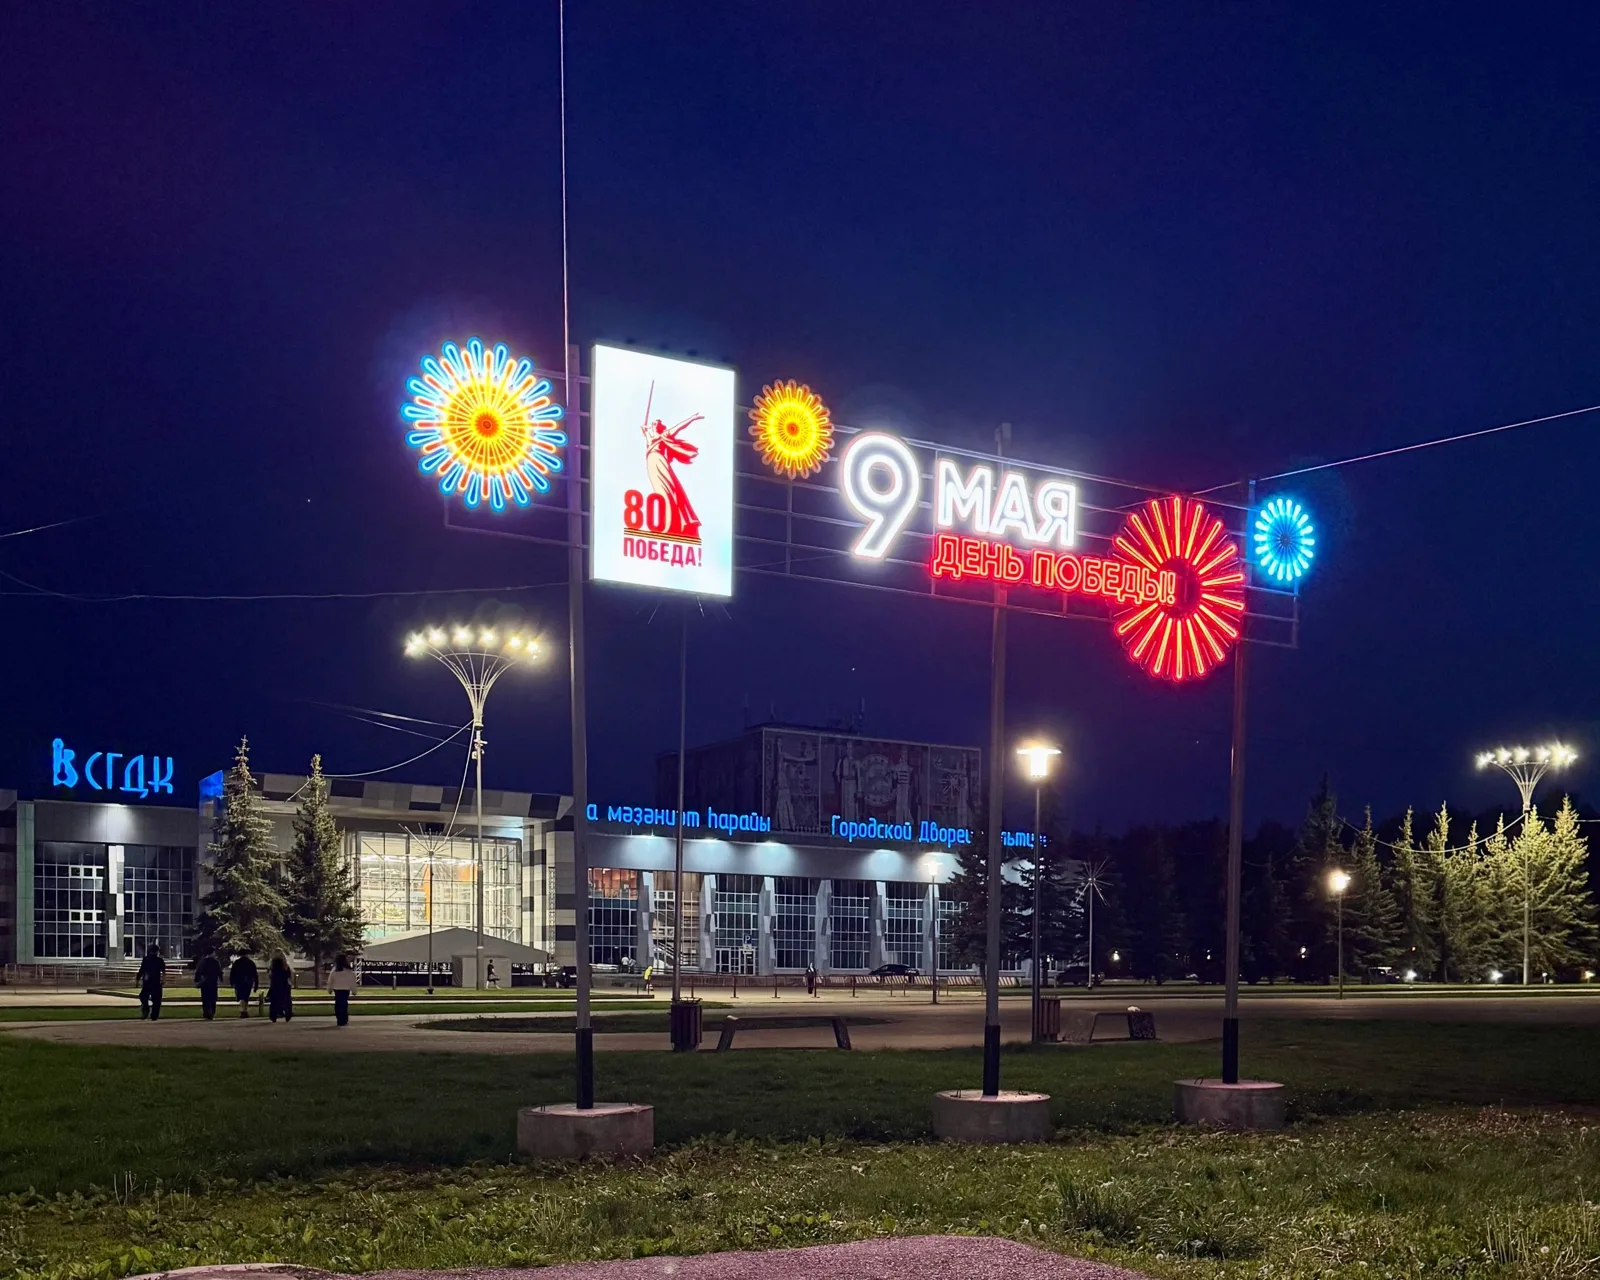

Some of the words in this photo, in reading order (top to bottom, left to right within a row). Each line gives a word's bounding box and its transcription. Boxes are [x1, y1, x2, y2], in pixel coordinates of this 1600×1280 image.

[623, 488, 667, 533] 80
[841, 431, 920, 561] 9
[935, 458, 1079, 549] МАЯ
[623, 536, 703, 568] ПОБЕДА!
[931, 533, 1026, 582] ДЕНЬ
[1031, 550, 1178, 606] ПОБЕДЫ!
[85, 751, 173, 798] СГДК
[831, 815, 912, 842] Городской
